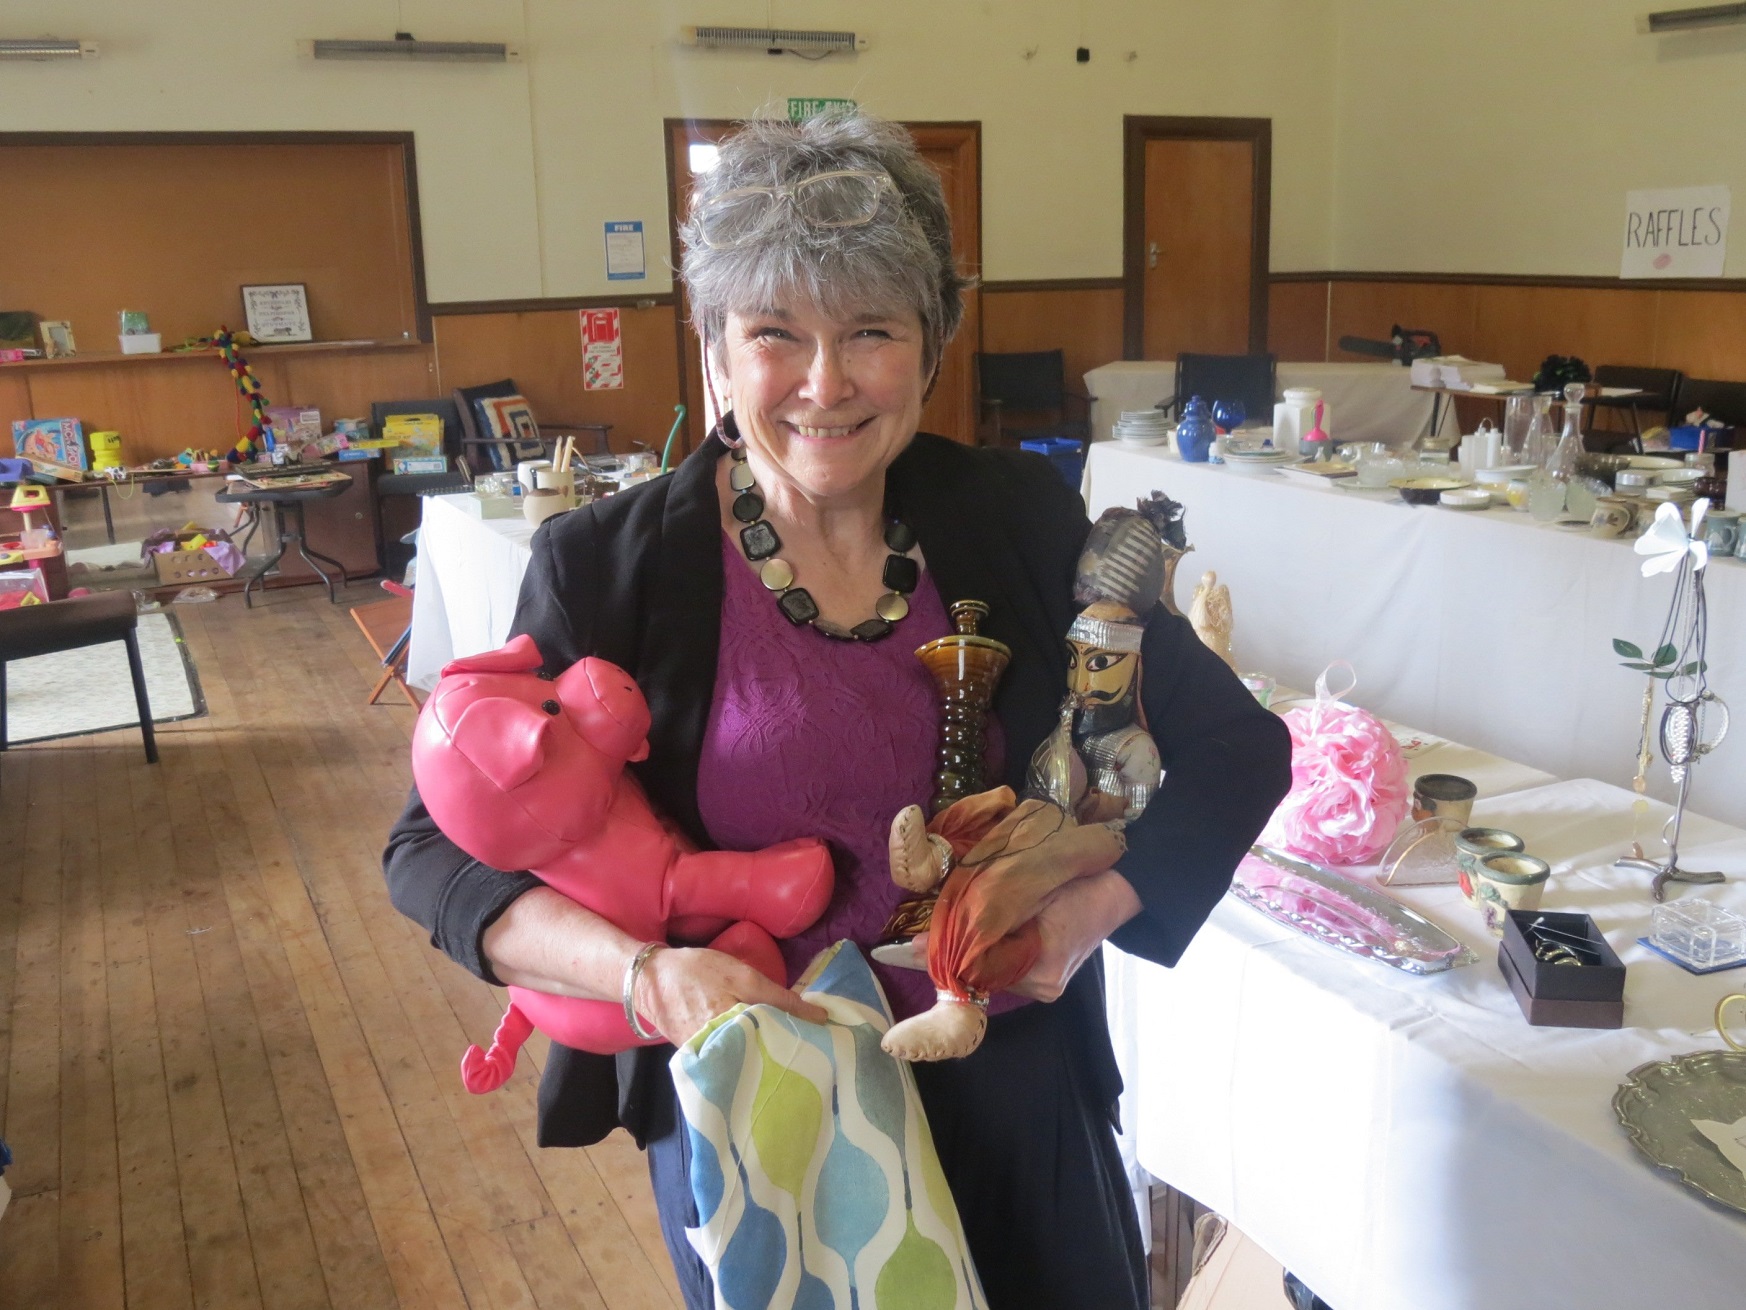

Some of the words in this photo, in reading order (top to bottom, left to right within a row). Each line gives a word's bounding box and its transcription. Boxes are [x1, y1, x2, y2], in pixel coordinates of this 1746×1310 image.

[790, 101, 819, 118] FIRE
[614, 224, 634, 232] FIRE
[1626, 207, 1721, 248] RAFFLES
